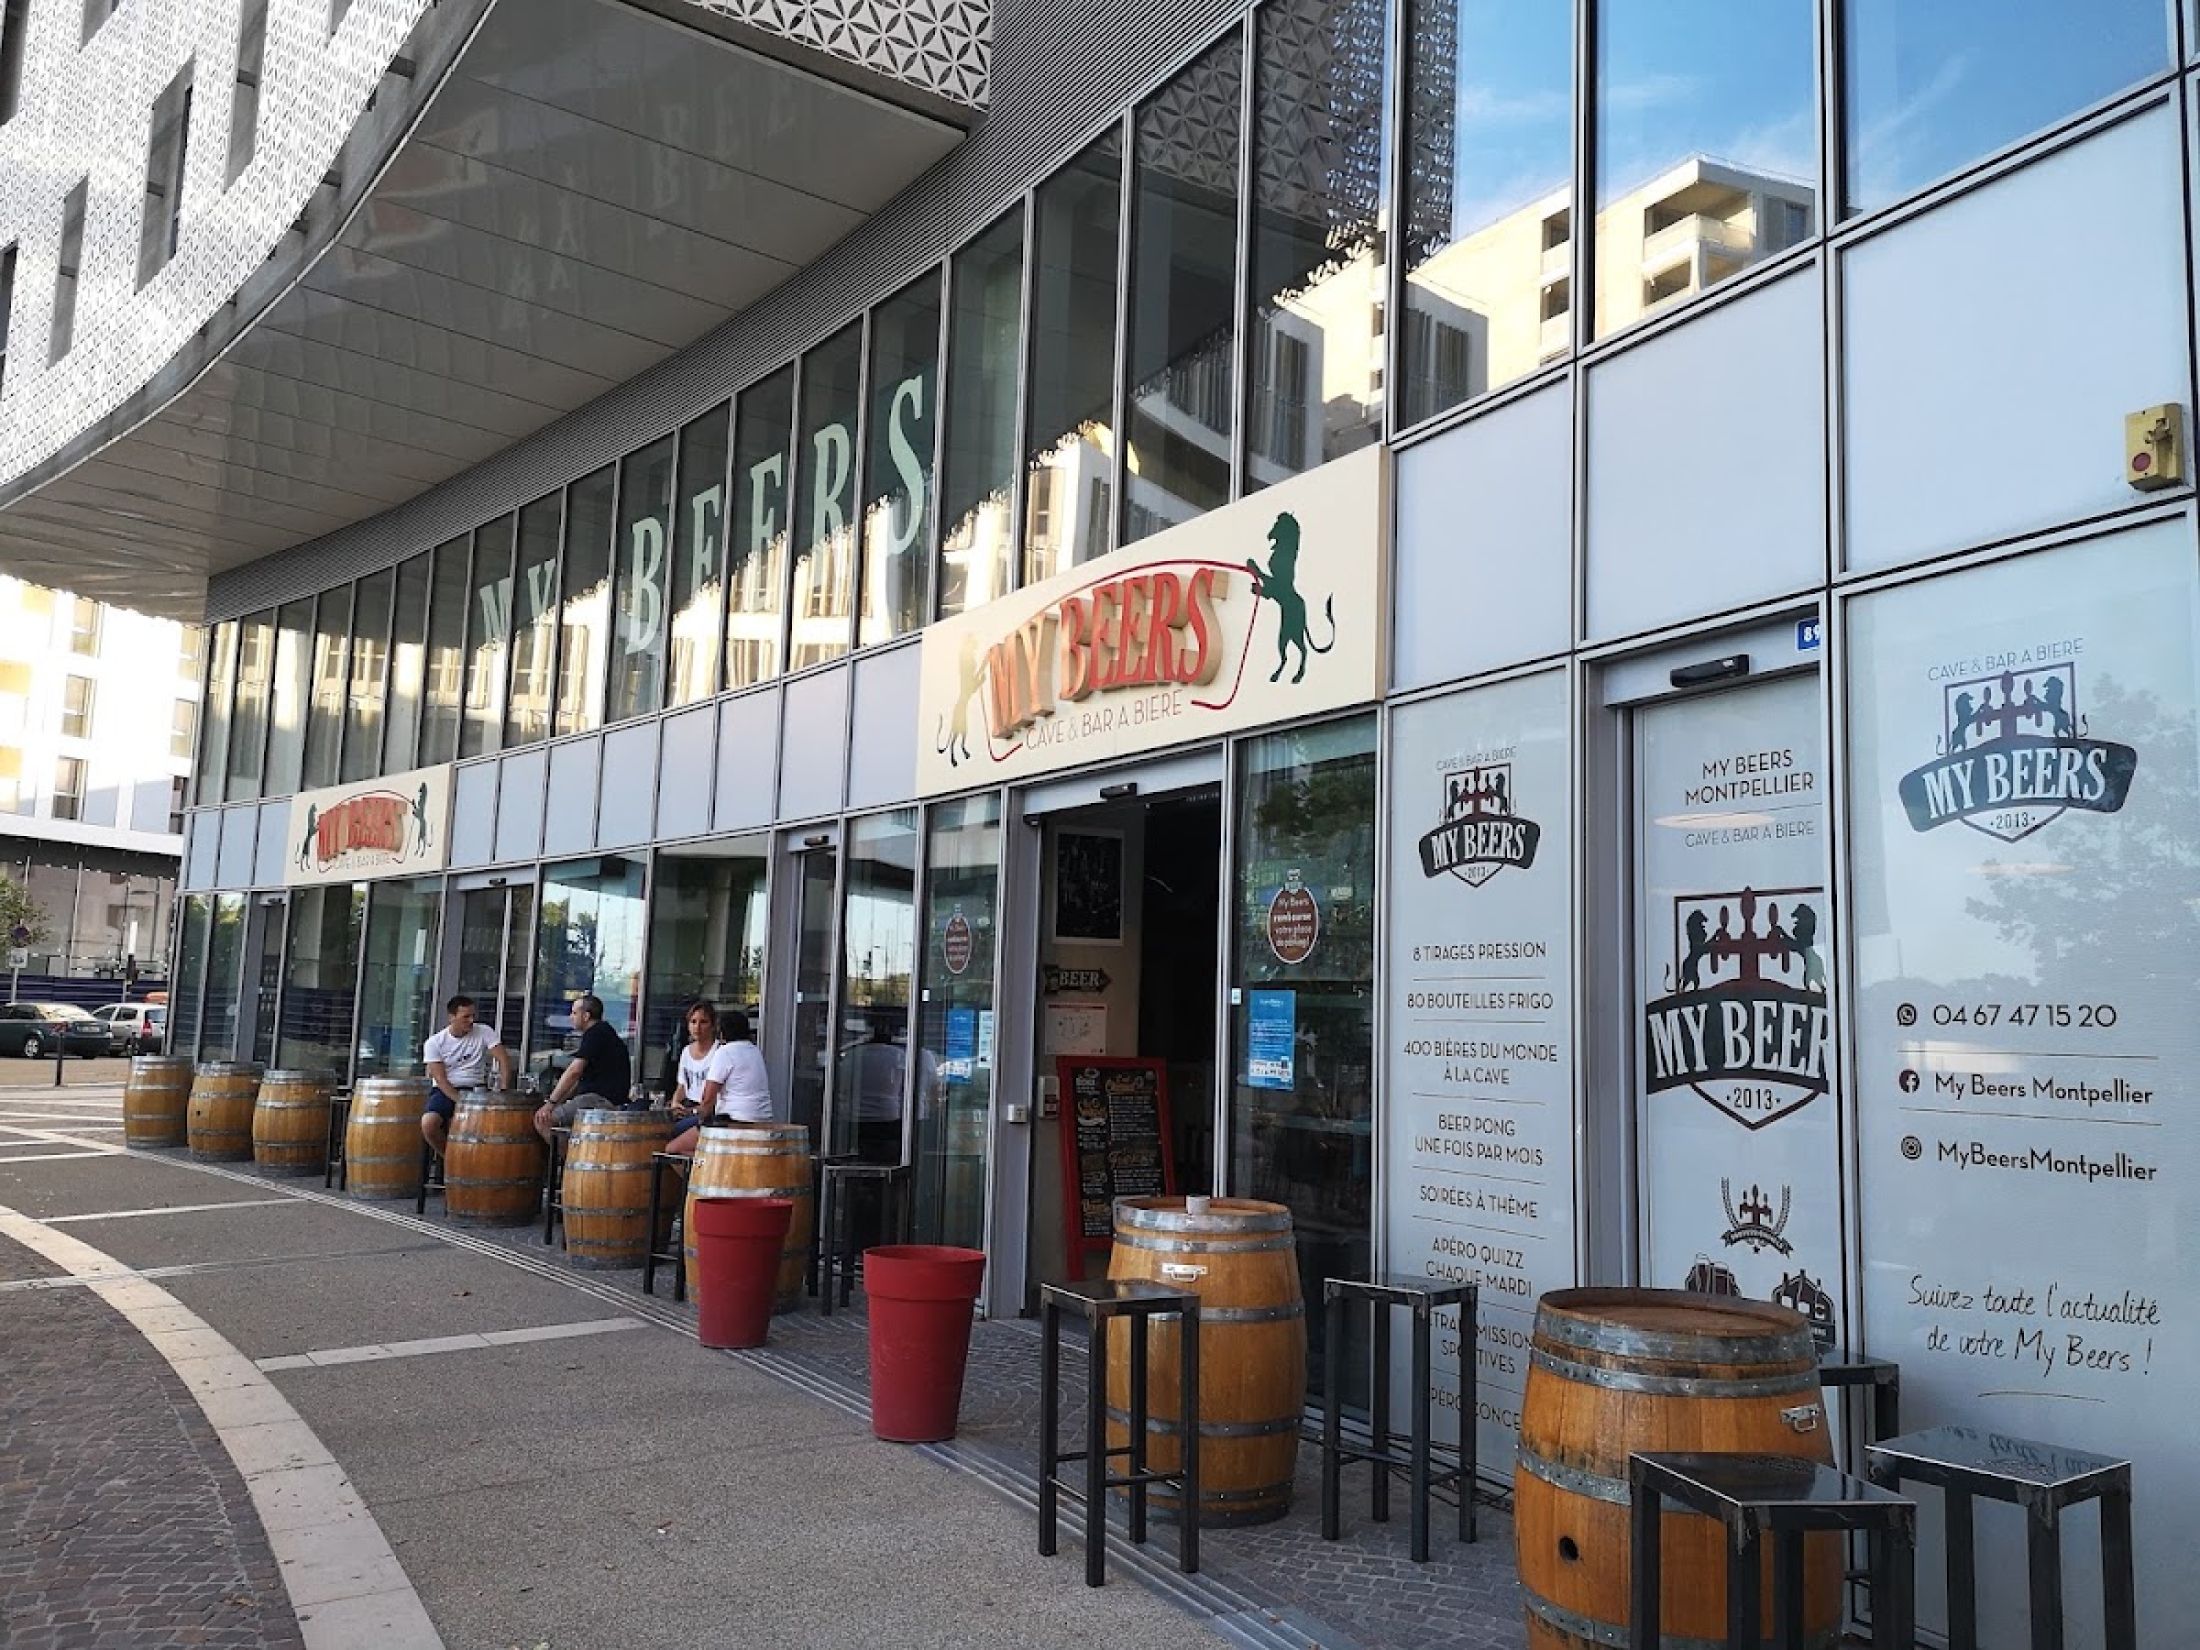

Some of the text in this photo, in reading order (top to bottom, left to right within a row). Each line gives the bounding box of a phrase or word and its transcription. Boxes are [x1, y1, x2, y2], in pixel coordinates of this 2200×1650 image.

[625, 375, 923, 655] BEERS
[989, 568, 1229, 739] MY BEERS
[1928, 638, 2084, 682] CAVE & BAR A BIERE
[1026, 689, 1183, 750] CAVE & BAR A BIERE
[1702, 749, 1793, 779] MY BEERS
[1685, 771, 1814, 805] MONTPELLIER
[1922, 747, 2109, 819] MY BEERS
[1685, 830, 1718, 848] CAVE
[1733, 827, 1759, 843] BAR
[1775, 820, 1814, 839] BIERE
[1996, 812, 2030, 829] 2013
[1431, 821, 1526, 870] MY BEERS
[1413, 941, 1547, 962] 8 TIRAGES PRESSION
[1059, 970, 1100, 987] BEER
[1407, 993, 1554, 1010] 80 BOUTEILLES FRIGO
[1404, 1040, 1432, 1056] 400
[1481, 1042, 1499, 1059] DU
[1503, 1043, 1558, 1063] MONDE
[1648, 1003, 1708, 1079] MY
[1444, 1060, 1510, 1085] À LA CAVE
[1734, 1087, 1772, 1110] 2013
[1935, 1073, 2154, 1107] My Beers Montpellier
[1438, 1114, 1515, 1137] BEER PONG
[1415, 1136, 1543, 1167] UNE FOIS PAR MOIS
[1938, 1140, 2157, 1182] MyBeersMontpellier
[1420, 1185, 1539, 1219] SOIRÉES À THÈME
[1432, 1235, 1525, 1270] APÉRO QUIZZ
[1426, 1261, 1532, 1299] CHAQUE MARDI
[1908, 1274, 2161, 1326] Suivez toute l'actualité
[1927, 1325, 1951, 1352] de
[1958, 1329, 2007, 1359] votre
[2014, 1328, 2056, 1378] My
[2066, 1334, 2131, 1373] Beers
